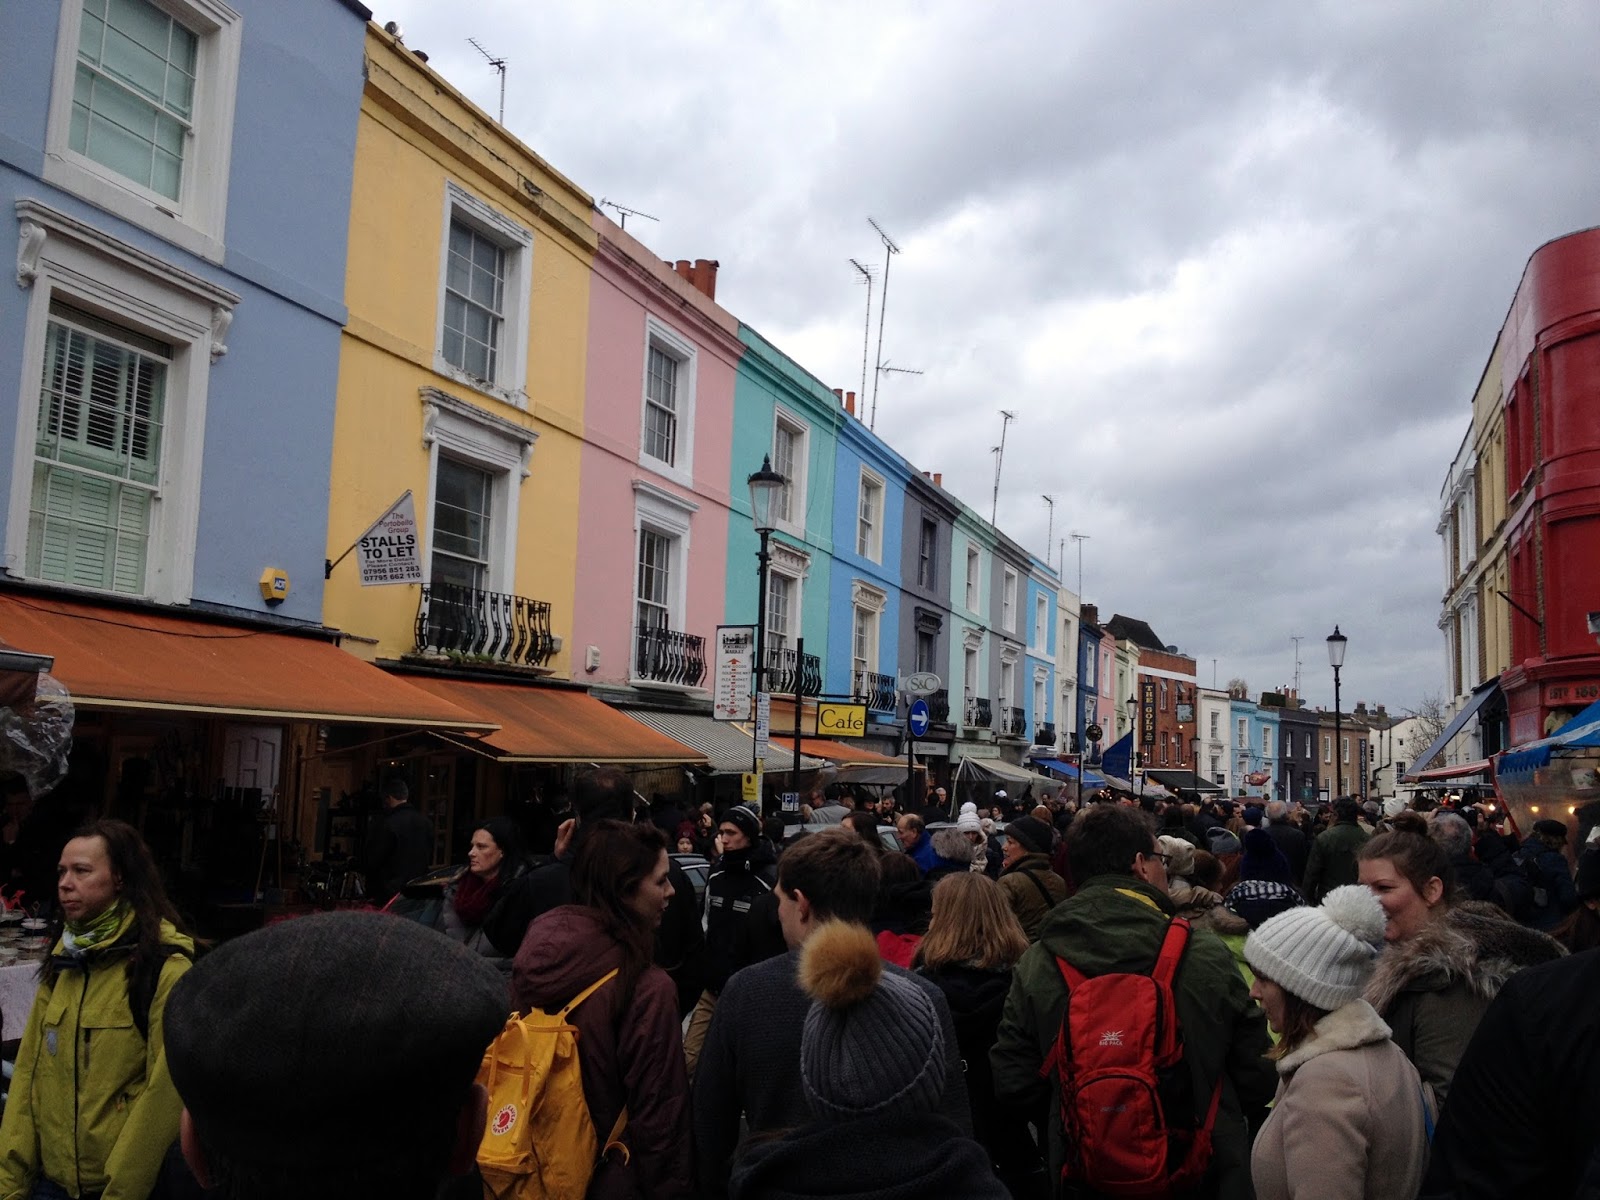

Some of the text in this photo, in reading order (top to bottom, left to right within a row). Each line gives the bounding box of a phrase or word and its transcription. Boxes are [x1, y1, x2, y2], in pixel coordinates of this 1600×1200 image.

[361, 534, 415, 548] STALLS
[363, 546, 415, 559] TO LET
[910, 677, 935, 691] S&C
[1145, 685, 1153, 731] THE GOLD
[820, 709, 863, 730] Café
